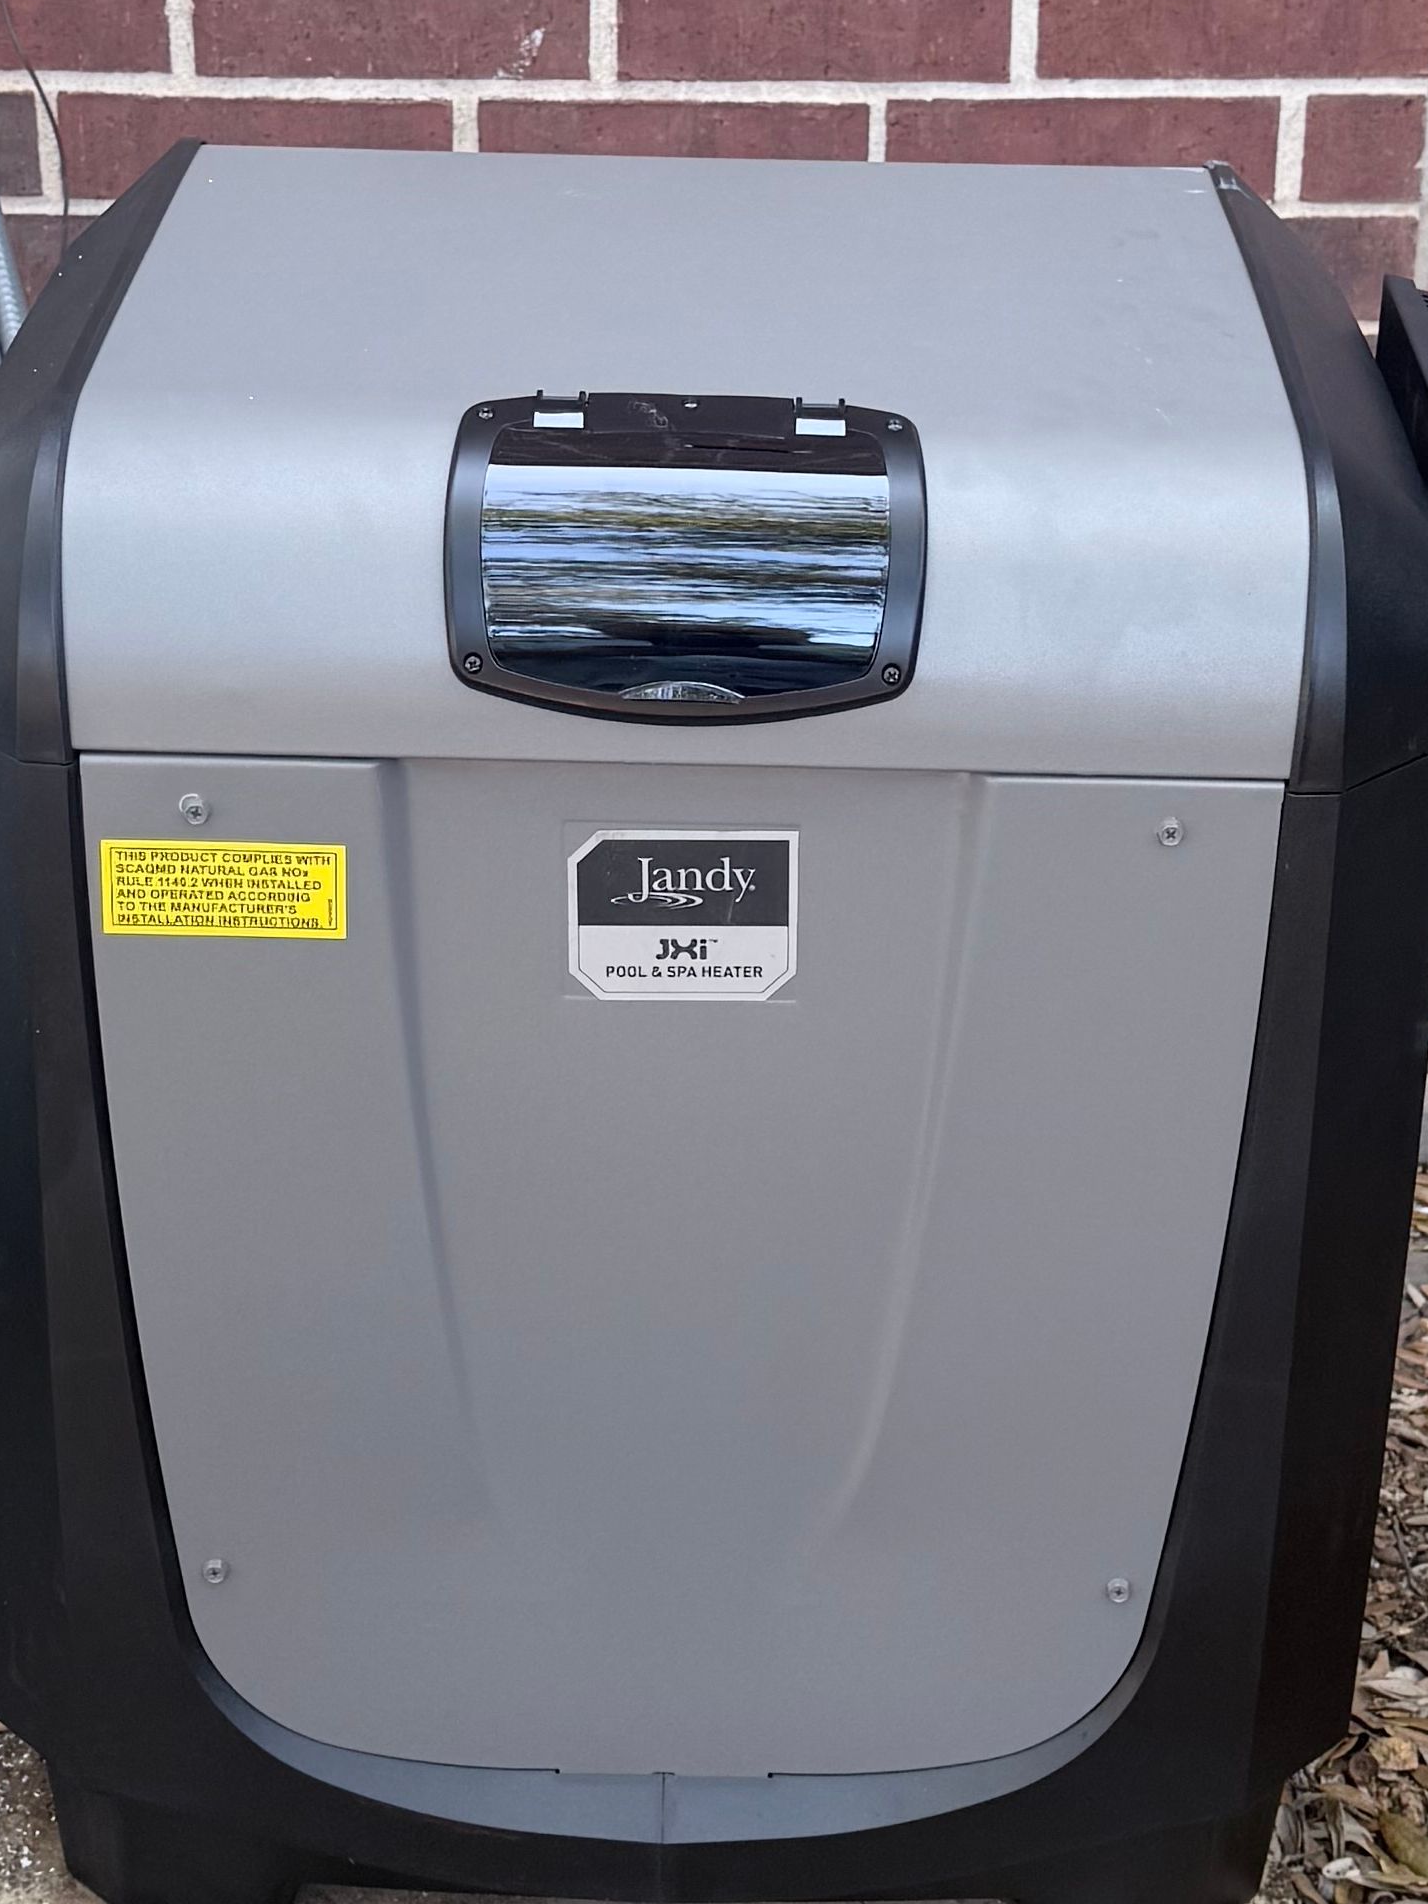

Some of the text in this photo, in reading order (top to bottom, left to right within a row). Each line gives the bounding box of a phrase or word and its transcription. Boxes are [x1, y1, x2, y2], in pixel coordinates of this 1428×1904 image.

[115, 851, 331, 866] THIS PRODUCT COMPLIES WITH
[181, 865, 244, 876] NATURAL
[116, 876, 153, 887] RULE
[247, 879, 321, 890] INSTALLED
[627, 856, 756, 903] Jandy
[116, 889, 311, 902] AND OPERATED ACCORDING
[118, 901, 297, 914] TO THE MANUFACTURER'S
[118, 913, 214, 925] INSTALLATION
[605, 965, 764, 979] POOL & SPA HEATER
